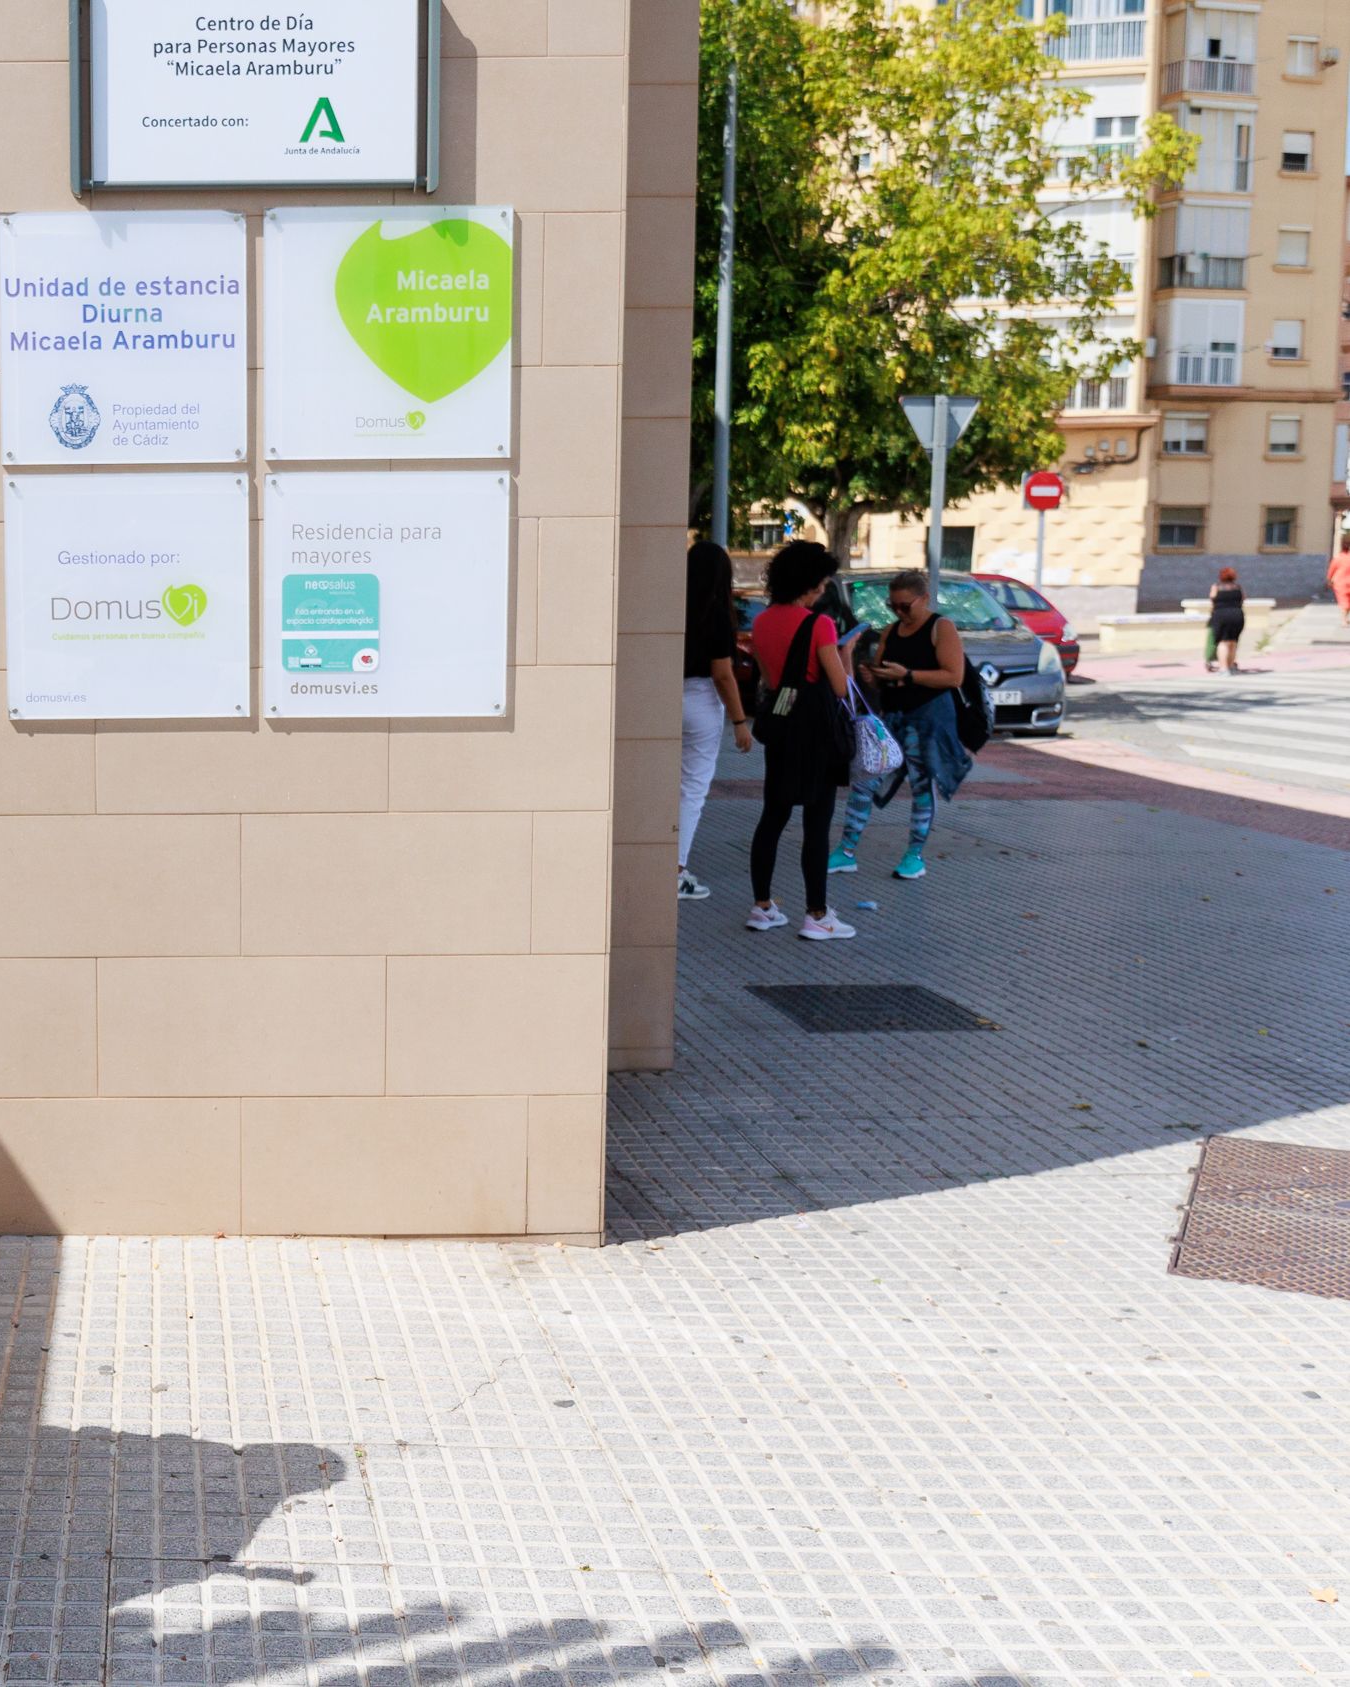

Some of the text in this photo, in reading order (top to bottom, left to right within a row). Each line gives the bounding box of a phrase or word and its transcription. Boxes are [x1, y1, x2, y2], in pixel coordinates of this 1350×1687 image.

[195, 13, 314, 31] Centro de Día
[153, 38, 355, 57] para Personas Mayores
[142, 115, 249, 129] Concertado con:
[284, 146, 360, 156] Junta de Andalucía
[4, 275, 240, 298] Unidad de estancia
[396, 270, 490, 291] Micaela
[82, 304, 163, 324] Diurna
[365, 302, 489, 324] Aramburu
[10, 330, 235, 351] Micaela Aramburu
[112, 403, 200, 418] Propiedad del
[112, 419, 200, 432] Ayuntamiento
[113, 433, 169, 446] de Cádiz
[291, 523, 442, 543] Residencia para
[57, 550, 181, 568] Gestionado por:
[292, 550, 372, 566] mayores
[92, 632, 129, 642] personas
[290, 681, 378, 695] domusvi.es
[25, 692, 87, 703] domusvi.es
[998, 692, 1019, 704] LPT
